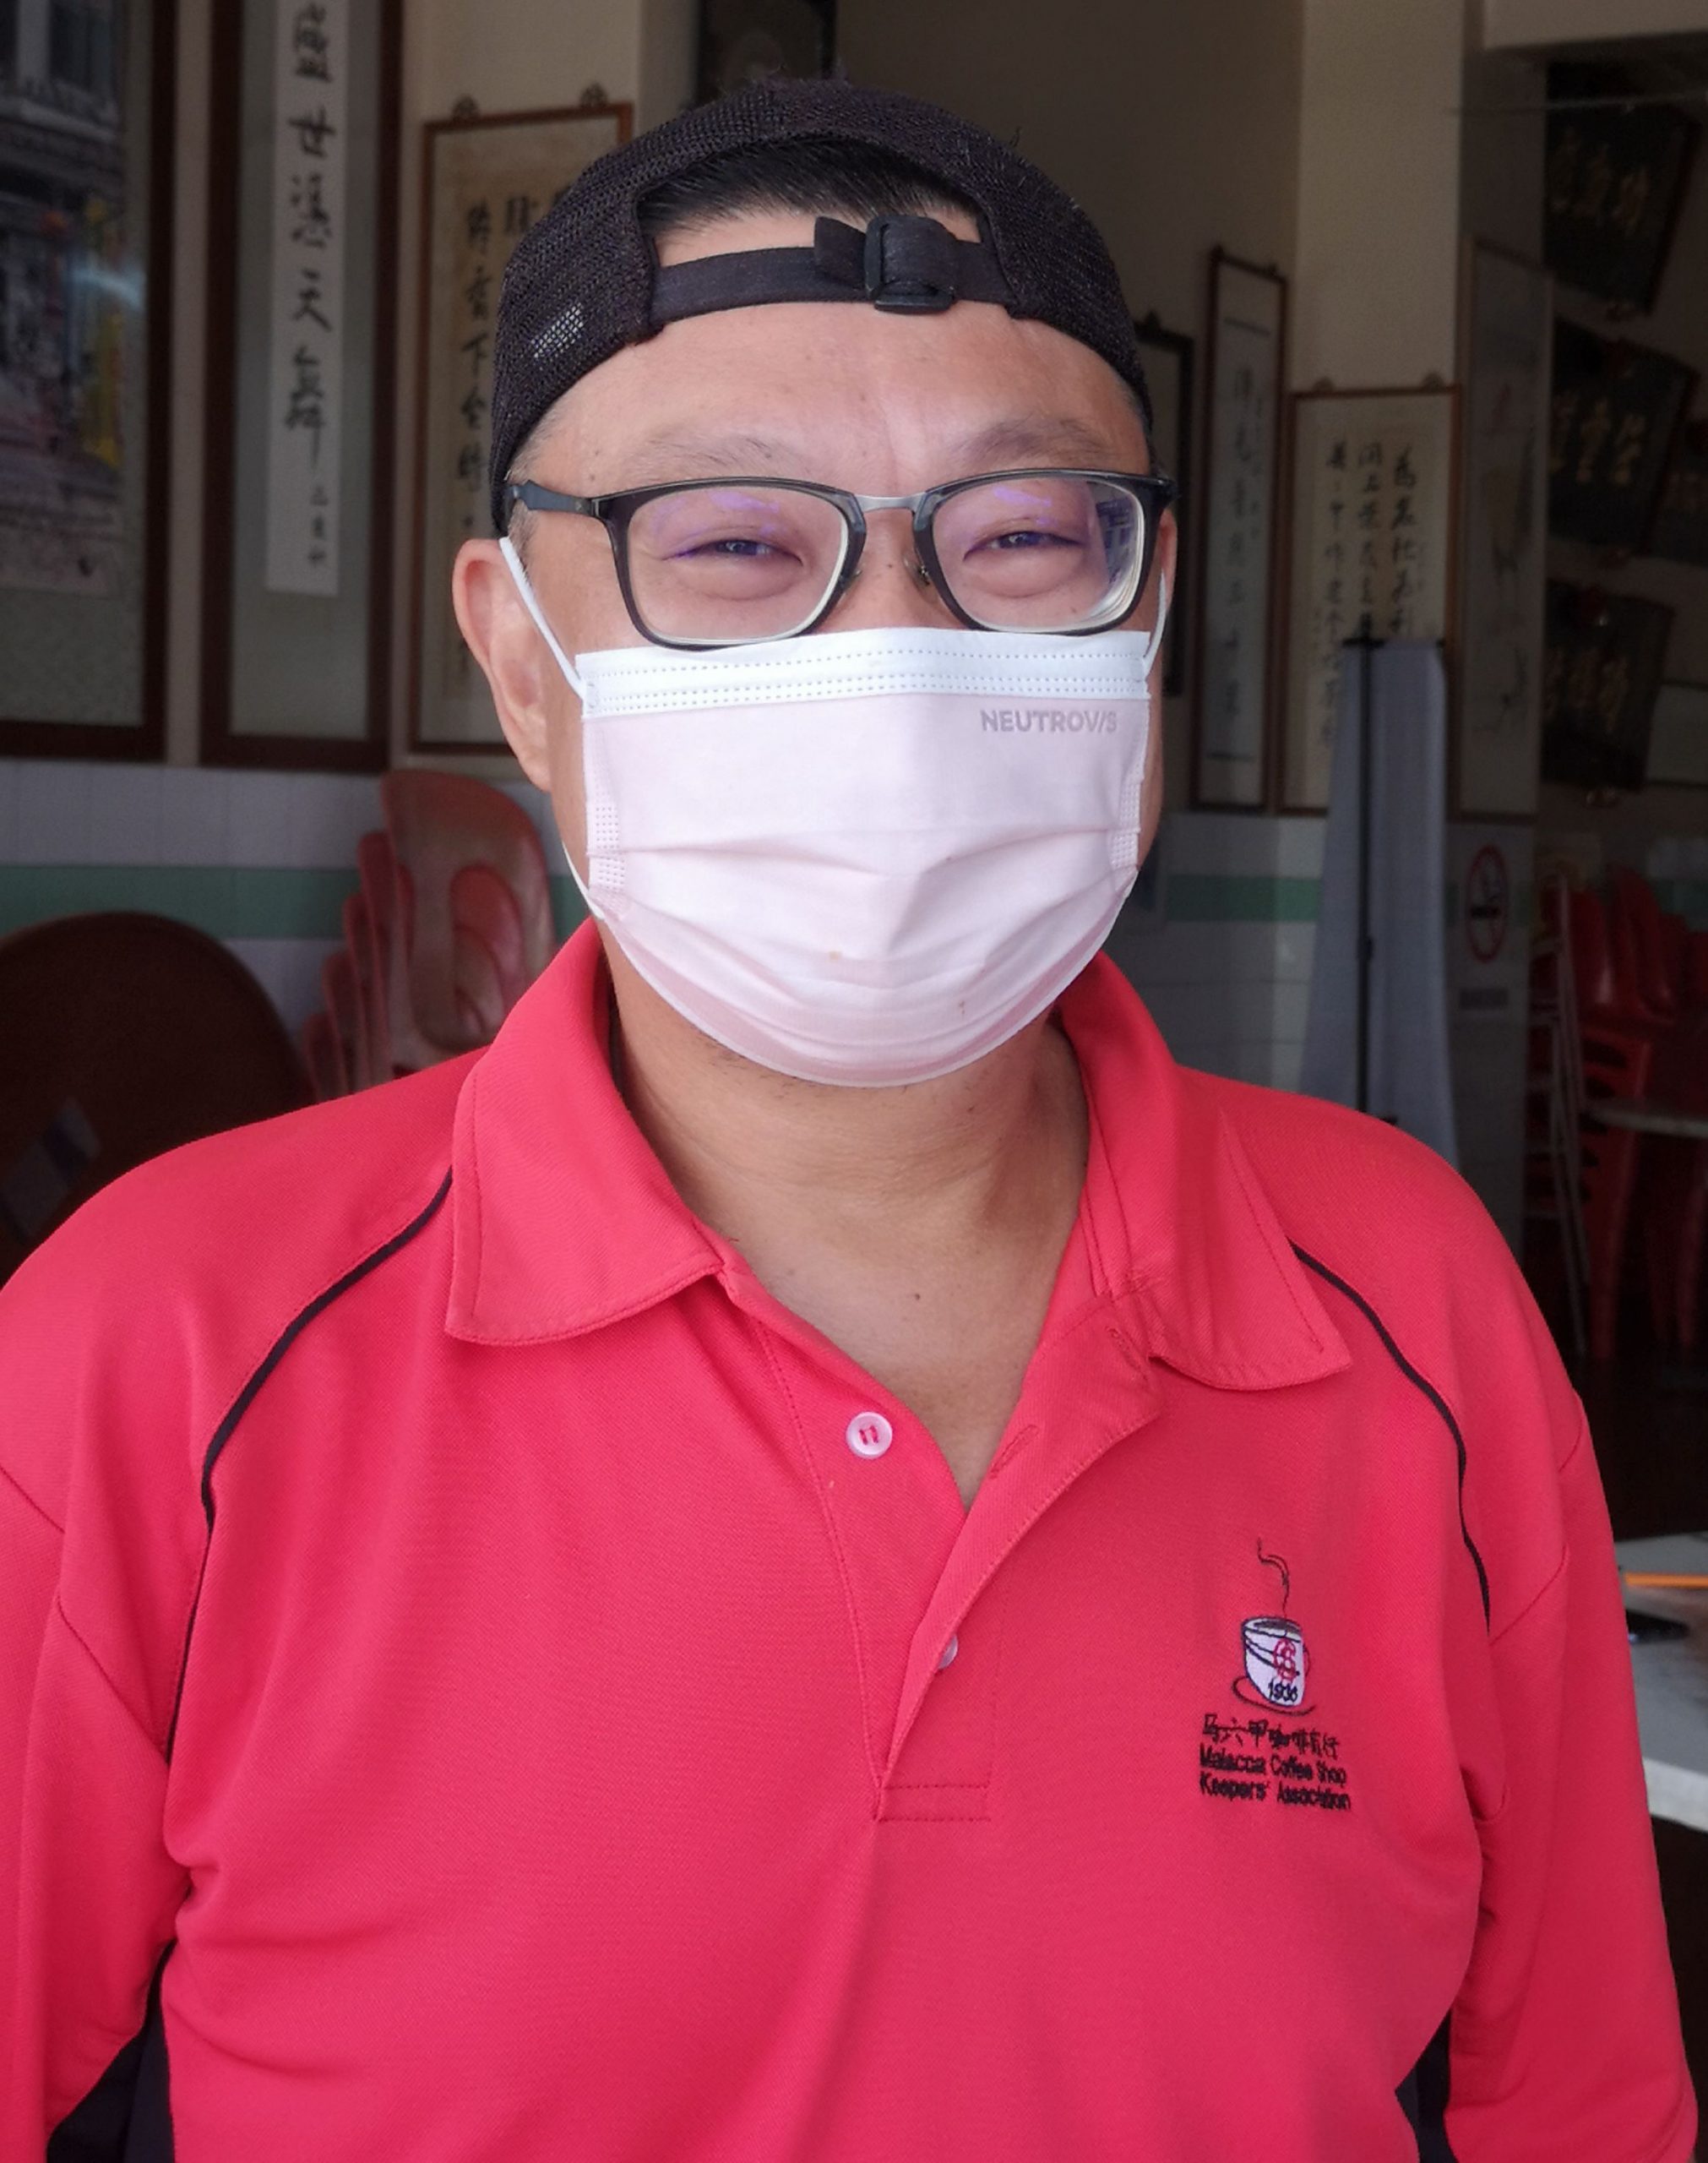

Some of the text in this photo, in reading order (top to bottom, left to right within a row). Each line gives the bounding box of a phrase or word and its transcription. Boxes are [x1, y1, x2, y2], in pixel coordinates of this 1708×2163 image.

[1200, 1744, 1346, 1787] Malacca Coffee Shop
[1277, 1782, 1352, 1810] Association
